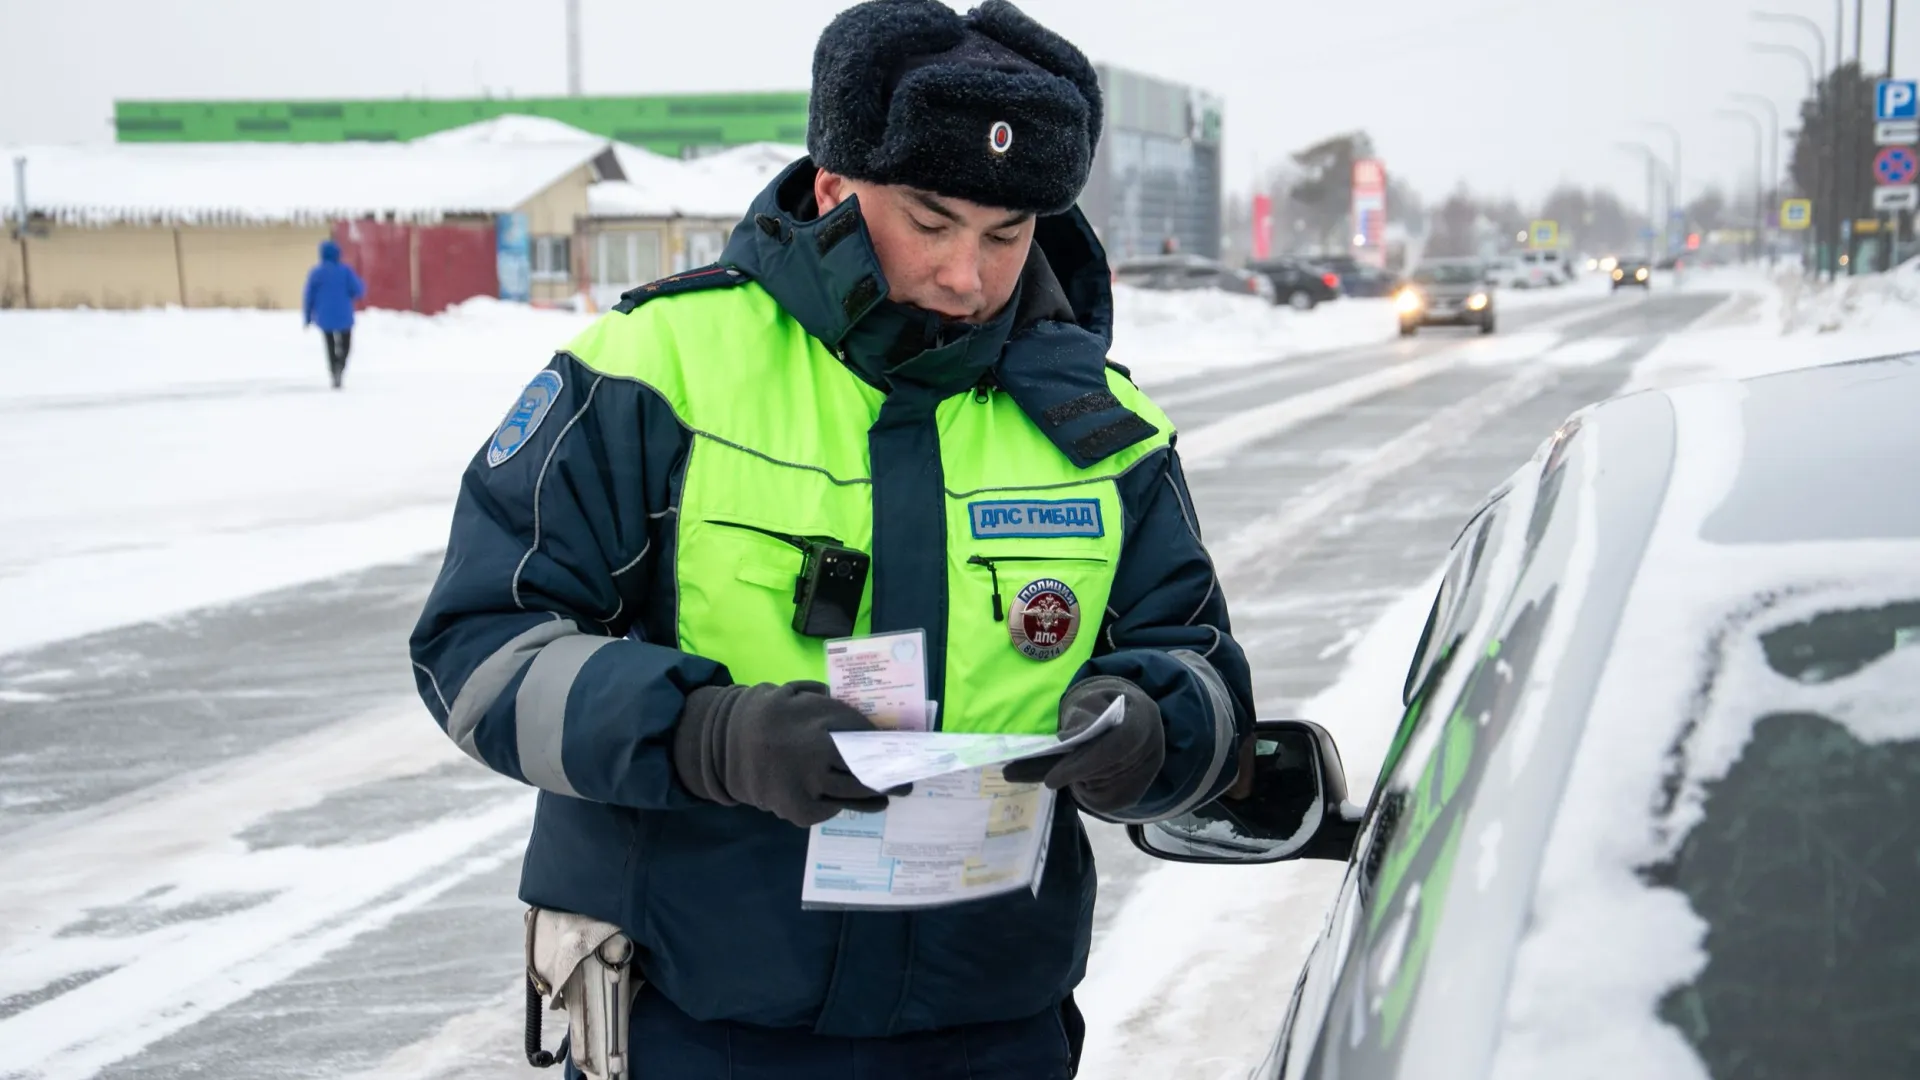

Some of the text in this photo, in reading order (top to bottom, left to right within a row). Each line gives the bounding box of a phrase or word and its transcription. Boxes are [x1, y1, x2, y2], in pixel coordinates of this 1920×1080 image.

[1884, 83, 1912, 118] P
[981, 506, 1094, 528] ДПС ГИБДД
[1020, 580, 1076, 605] ПОЛИЦИЯ
[1033, 631, 1058, 644] ДПС
[1023, 644, 1061, 660] 89-0214
